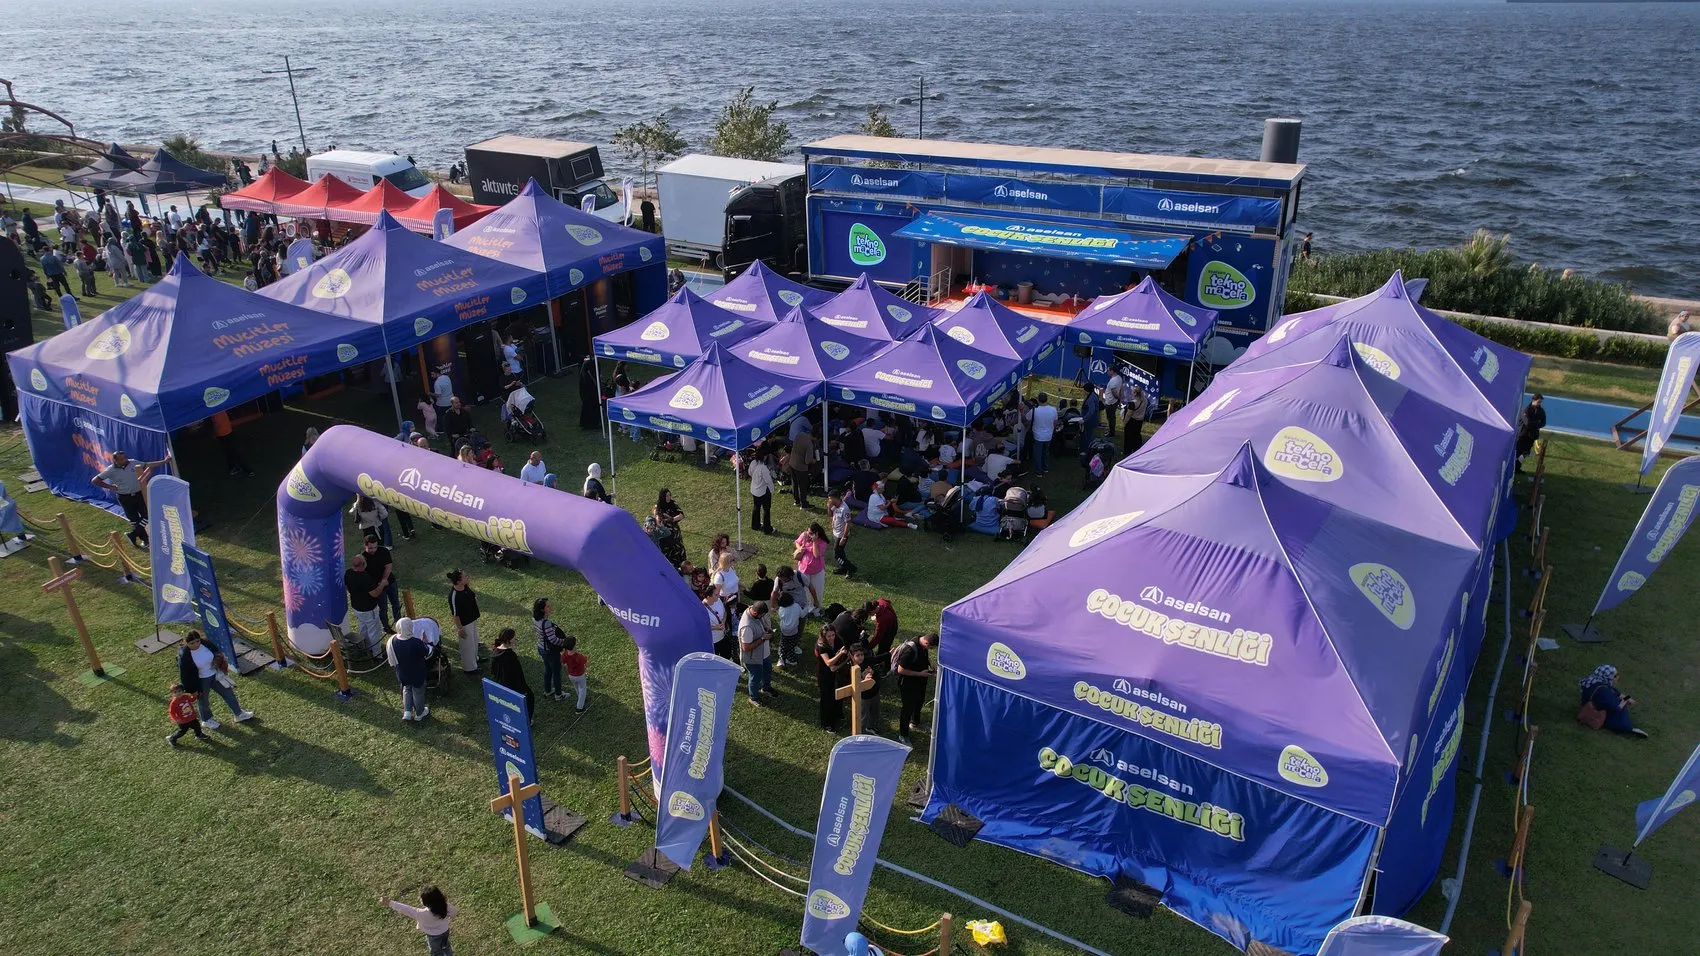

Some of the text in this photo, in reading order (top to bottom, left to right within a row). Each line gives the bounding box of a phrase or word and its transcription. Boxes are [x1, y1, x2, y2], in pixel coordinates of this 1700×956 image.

[864, 178, 898, 187] aselsan
[1009, 189, 1048, 200] aselsan
[1174, 202, 1219, 214] aselsan
[853, 244, 882, 258] macera
[856, 234, 879, 249] tekno
[416, 266, 474, 292] Mucitler
[1211, 273, 1246, 291] tekno
[1205, 285, 1248, 301] macera
[213, 322, 289, 349] Mucitler
[259, 354, 308, 376] Mucitler
[1274, 451, 1332, 475] macera
[1285, 440, 1332, 464] tekno
[421, 479, 484, 510] aselsan
[1164, 595, 1231, 623] aselsan
[1087, 588, 1273, 666] ÇOCUK ŞENLİĞİ
[995, 651, 1019, 667] tekno
[1133, 687, 1187, 714] aselsan
[686, 708, 696, 742] aselsan
[1073, 680, 1222, 750] ÇOCUK ŞENLİĞİ
[1117, 759, 1194, 796] aselsan
[1284, 763, 1321, 782] macera
[1290, 756, 1320, 775] tekno
[1038, 746, 1245, 842] ÇOCUK ŞENLİĞİ
[832, 796, 848, 834] aselsan
[834, 773, 876, 876] ÇOCUK ŞENLİĞİ
